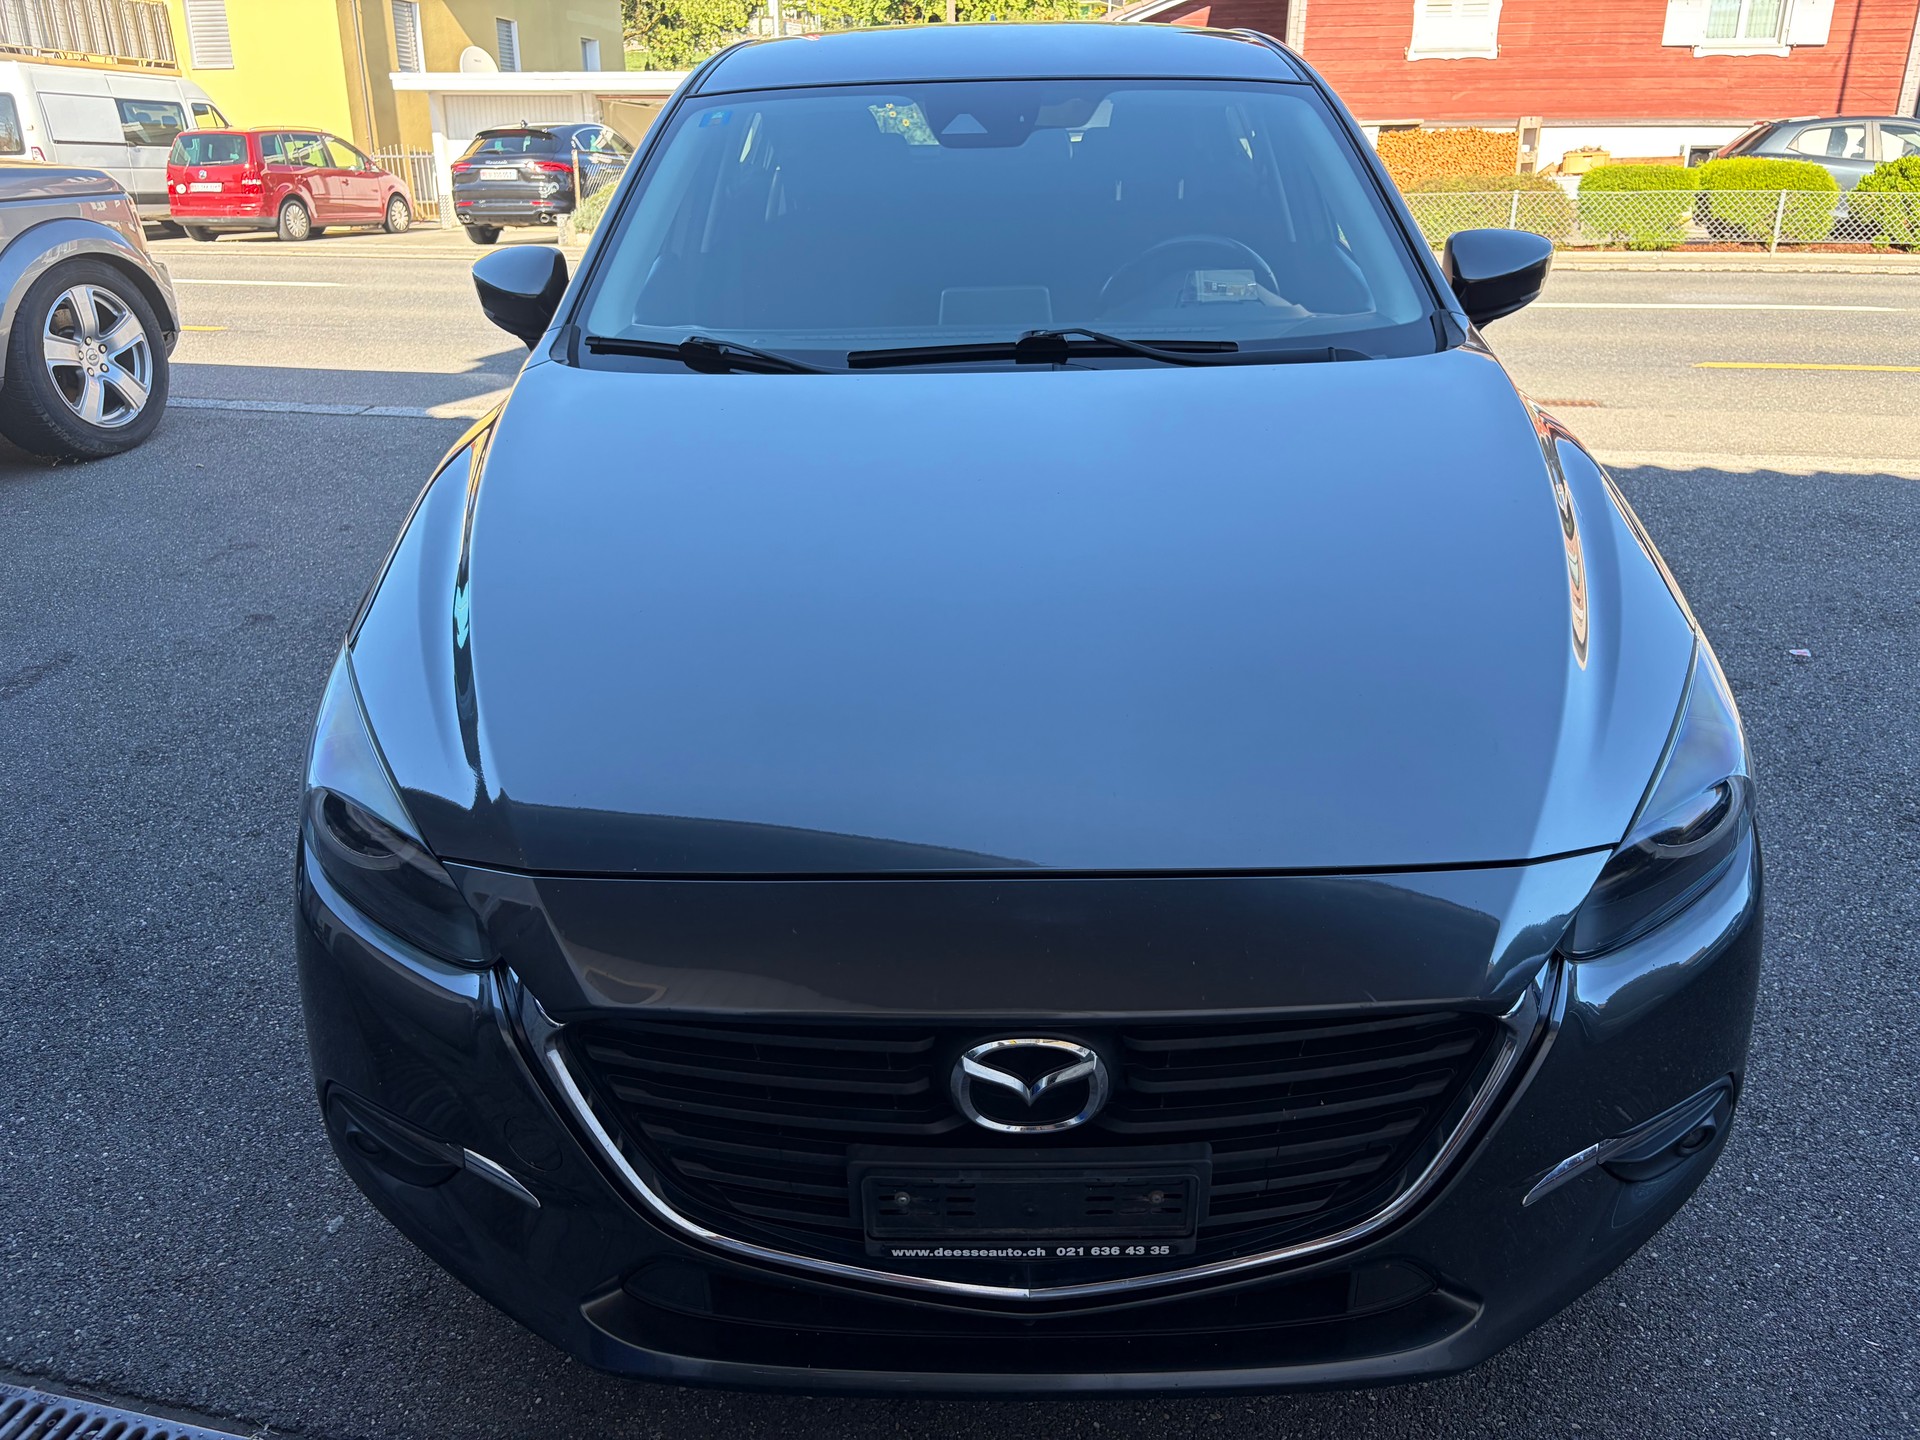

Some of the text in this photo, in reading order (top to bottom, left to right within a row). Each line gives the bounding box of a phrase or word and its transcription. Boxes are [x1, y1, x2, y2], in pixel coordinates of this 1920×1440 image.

[891, 1245, 1170, 1257] www.deesseauto.ch 021 636 43 35
